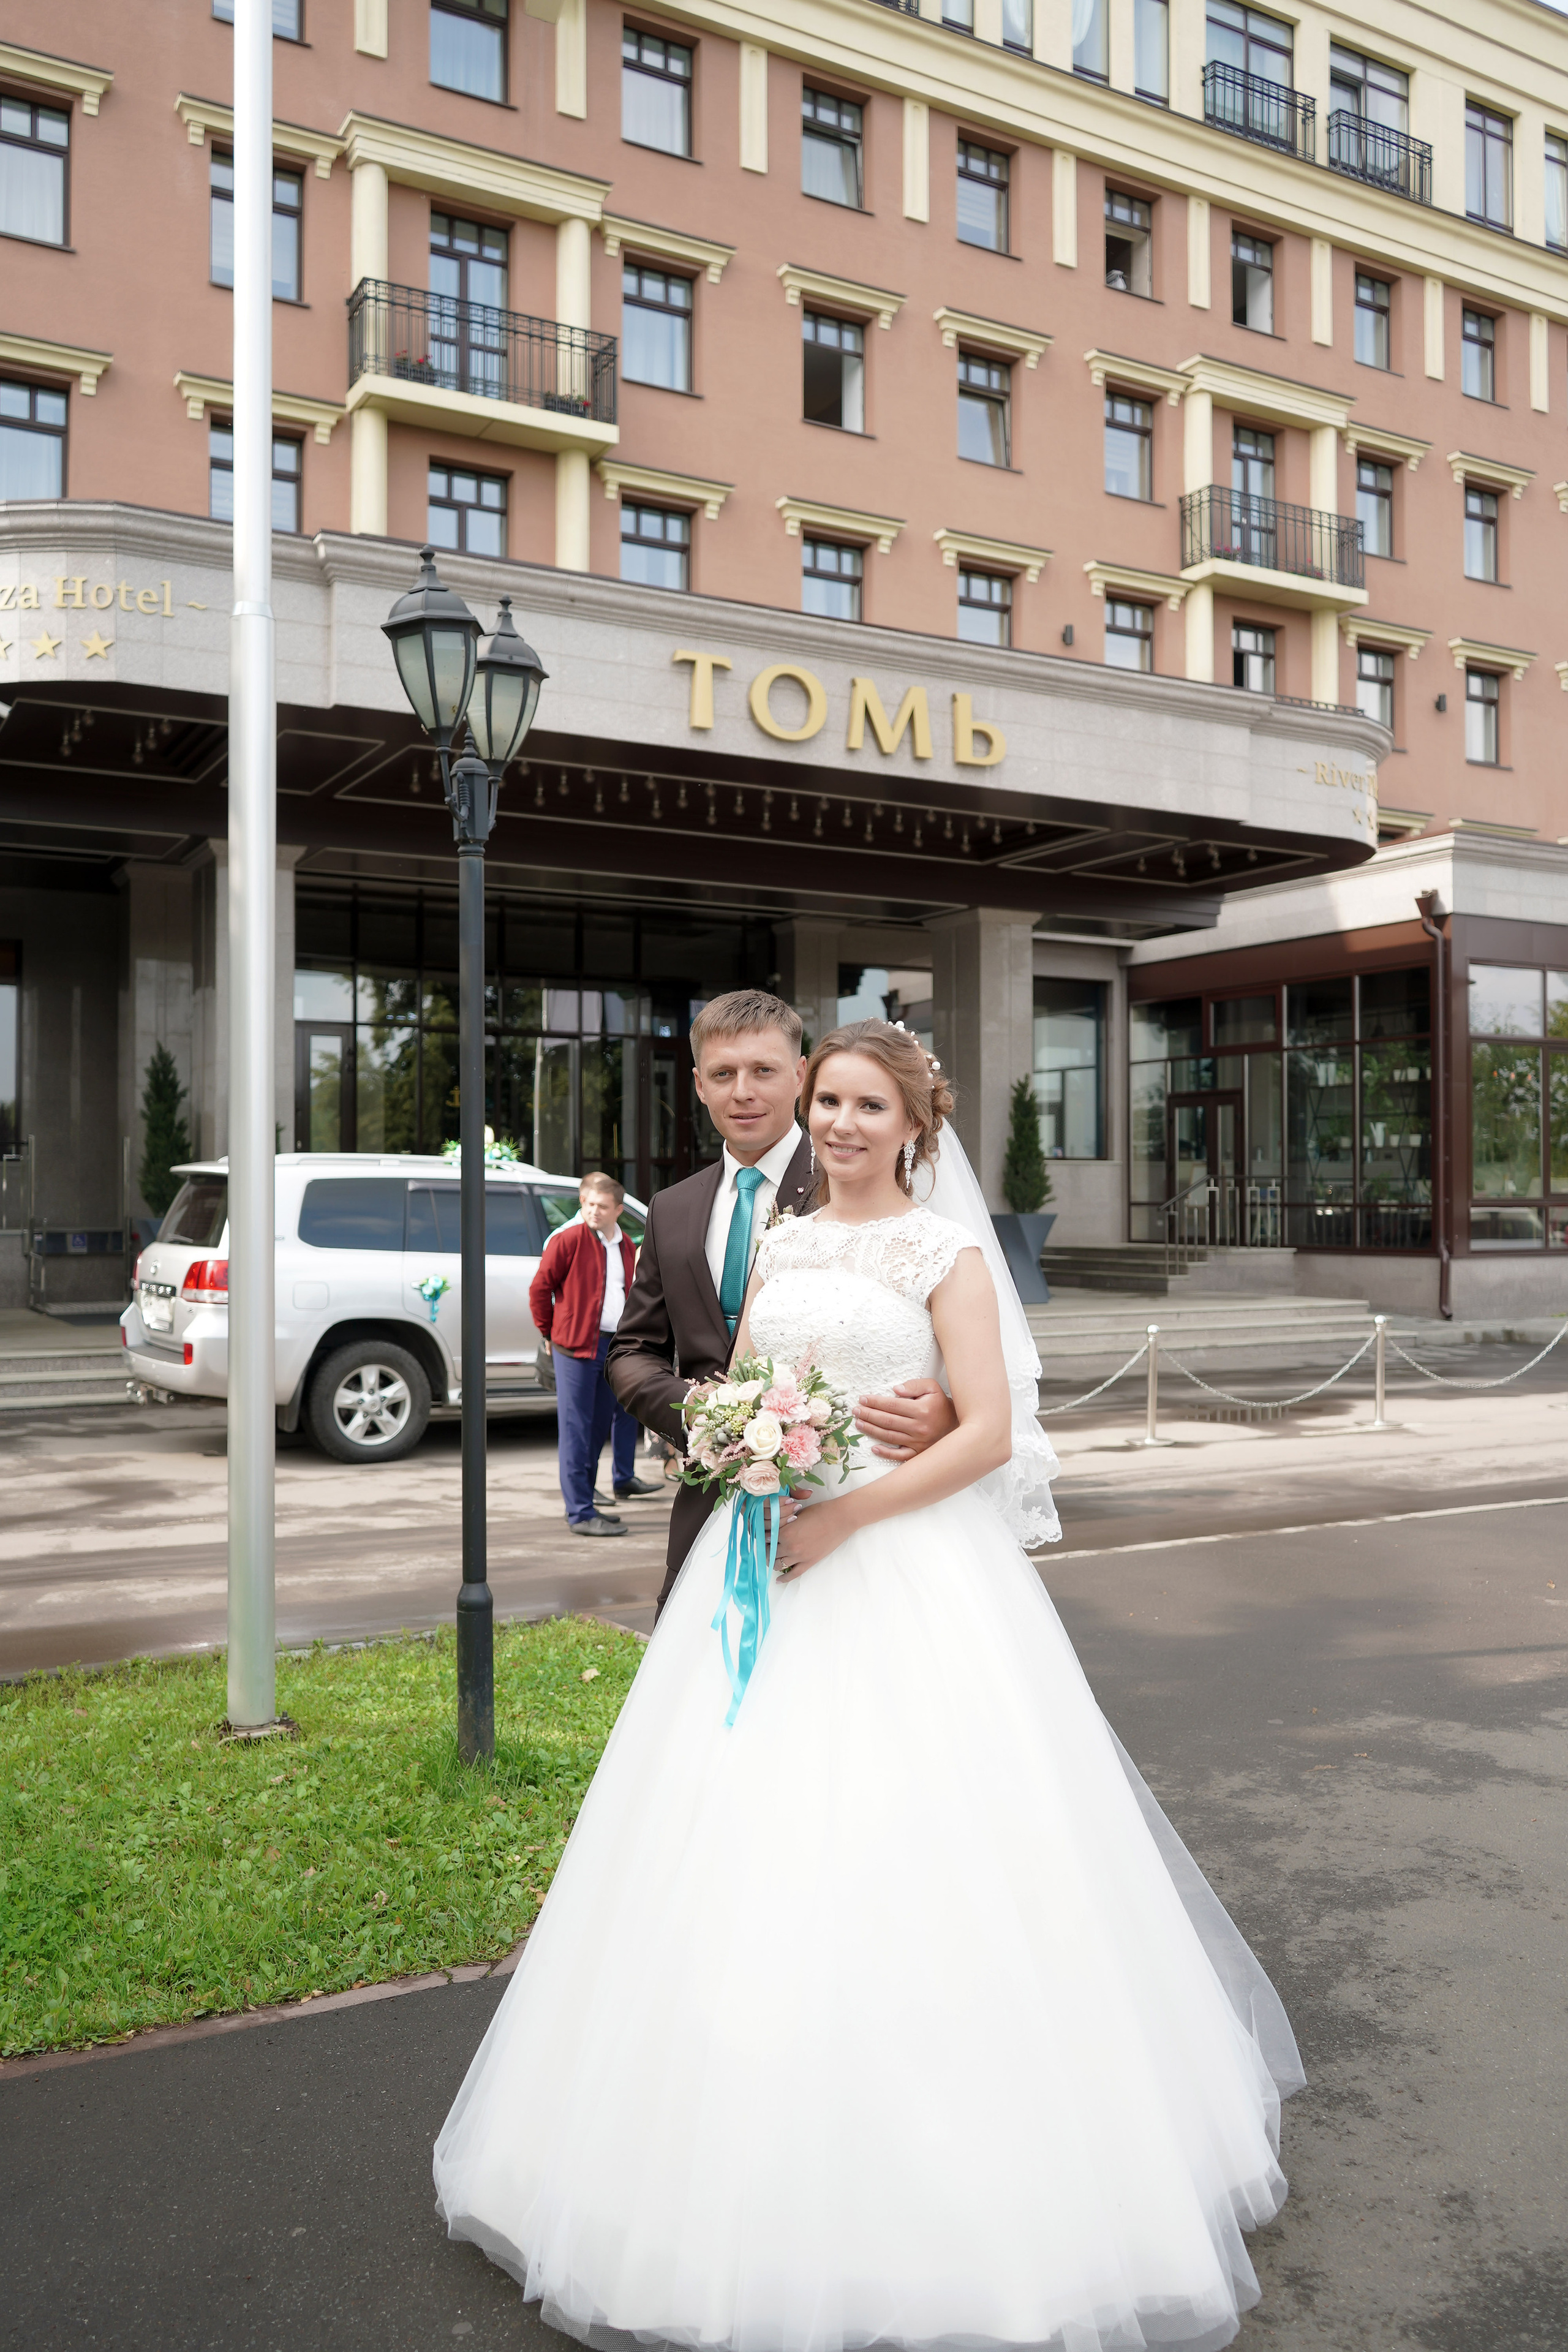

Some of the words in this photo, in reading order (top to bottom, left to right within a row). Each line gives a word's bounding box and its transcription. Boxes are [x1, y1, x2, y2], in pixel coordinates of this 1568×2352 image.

[52, 576, 175, 617] Hotel
[673, 649, 1008, 767] ТОМЬ
[1314, 761, 1365, 793] River
